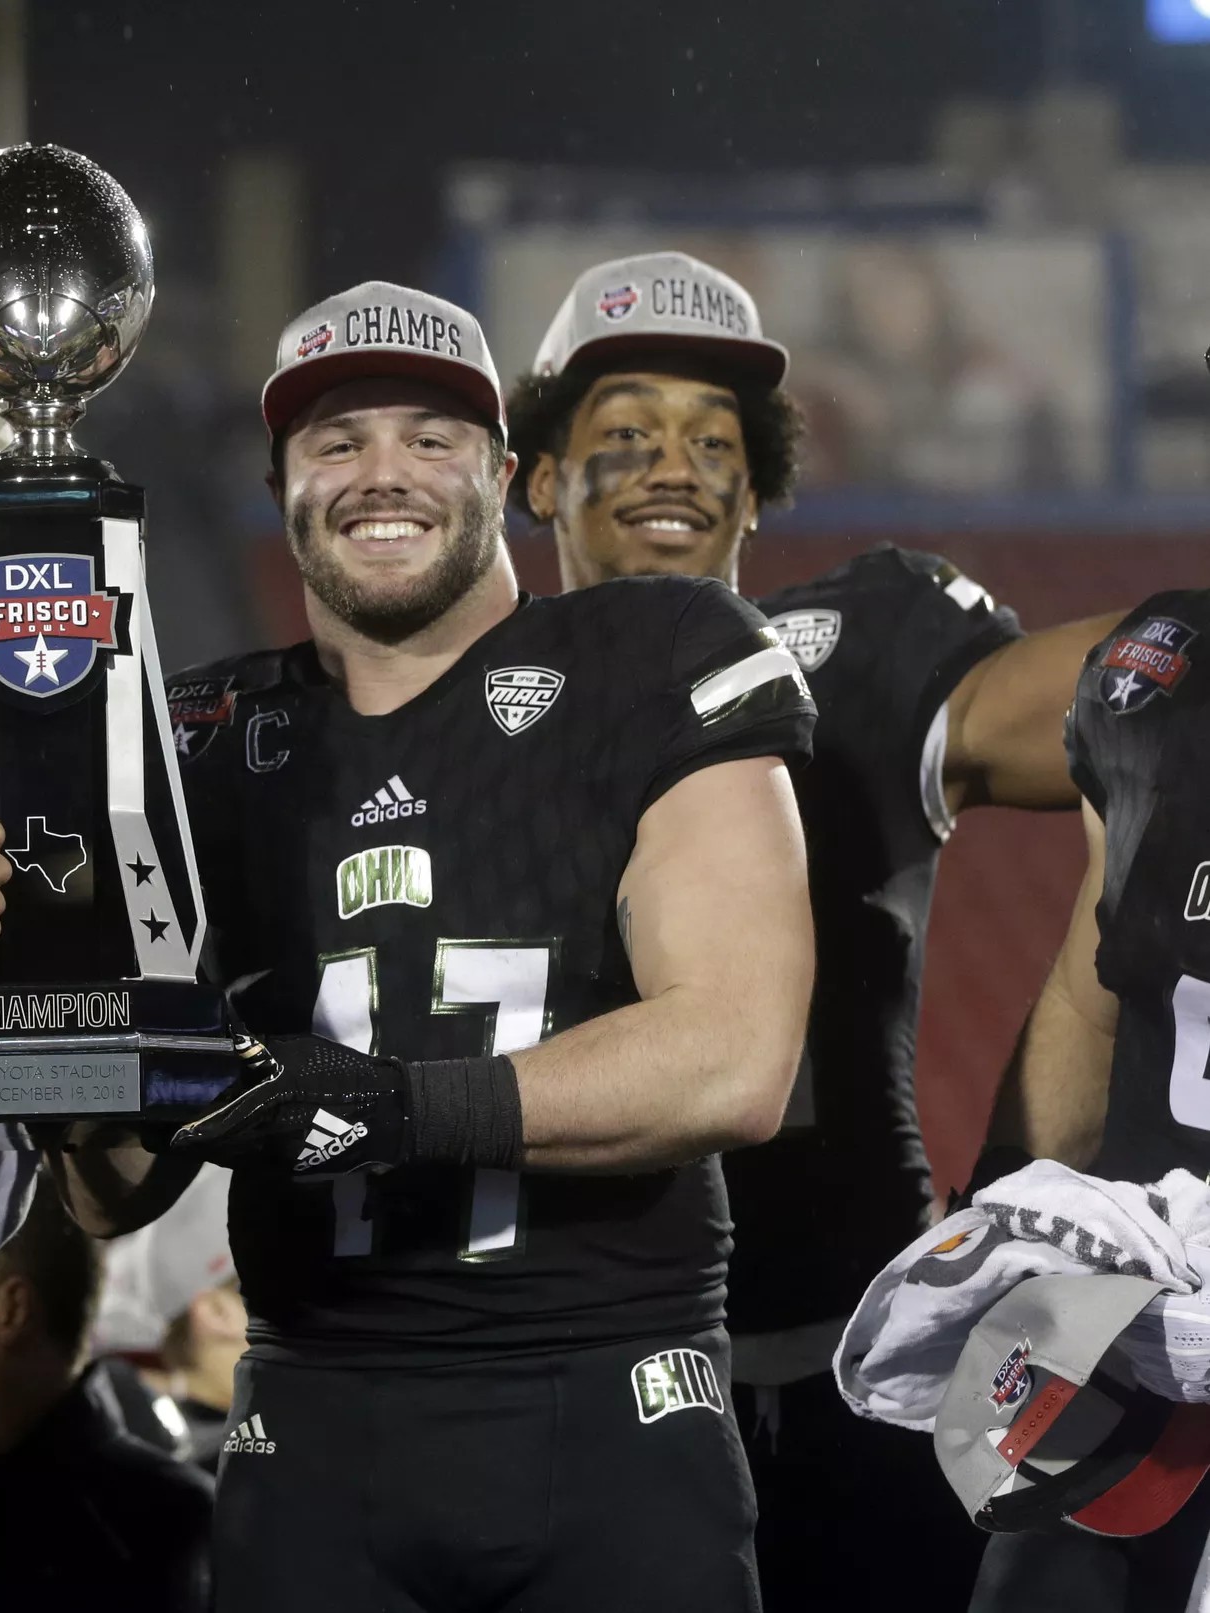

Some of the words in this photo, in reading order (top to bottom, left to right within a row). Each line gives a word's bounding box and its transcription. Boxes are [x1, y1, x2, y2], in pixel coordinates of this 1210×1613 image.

[652, 279, 748, 335] CHAMPS
[346, 306, 462, 357] CHAMPS
[5, 563, 73, 591] DXL
[13, 624, 66, 633] BOWL
[1141, 621, 1177, 647] DXL
[1118, 642, 1172, 673] FRISCO
[168, 682, 215, 701] DXL
[489, 686, 555, 707] MAC
[168, 700, 219, 714] ISCO
[247, 709, 290, 773] C
[351, 799, 427, 827] adidas
[336, 845, 433, 920] OHIO
[51, 1064, 126, 1079] STADIUM
[70, 1086, 87, 1102] 19,
[93, 1085, 126, 1101] 2018
[312, 942, 553, 1258] 17
[293, 1121, 369, 1172] adidas
[997, 1357, 1017, 1382] DXL
[999, 1358, 1025, 1394] FRISCO
[631, 1348, 724, 1424] OHIO
[223, 1437, 277, 1454] adidas
